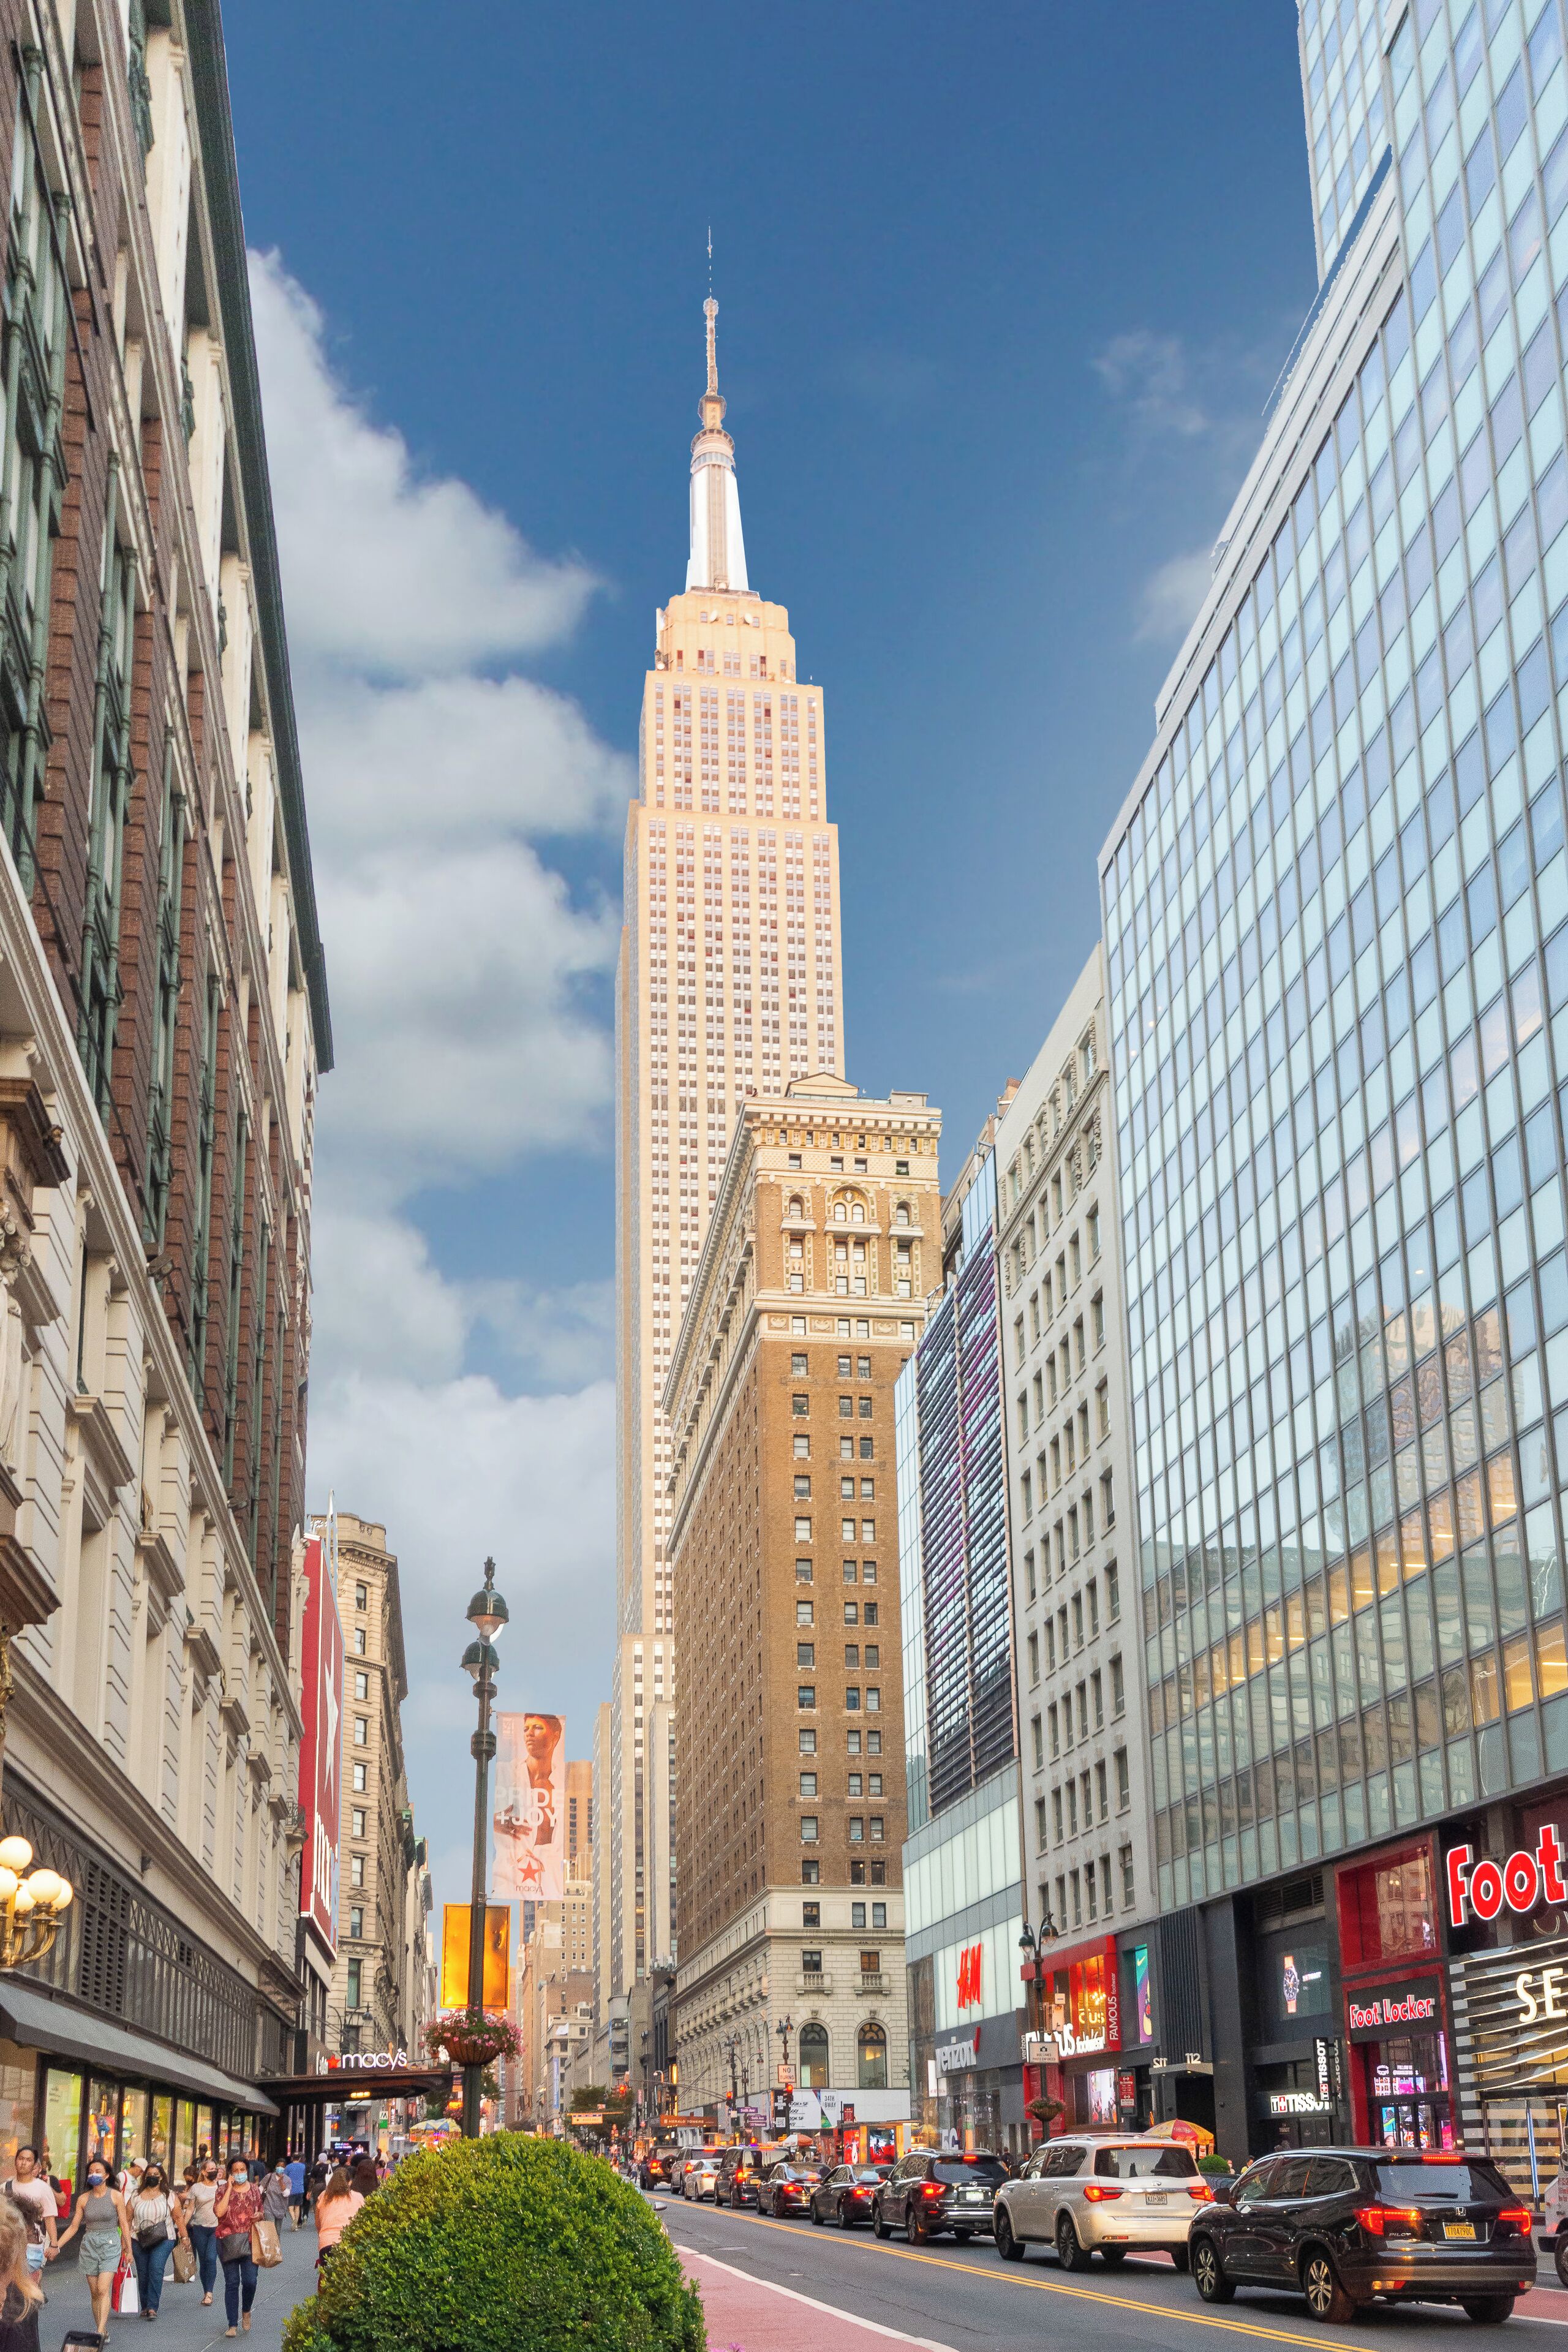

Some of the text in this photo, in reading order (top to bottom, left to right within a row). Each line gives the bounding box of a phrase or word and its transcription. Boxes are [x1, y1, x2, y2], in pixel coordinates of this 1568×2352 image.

[496, 1787, 565, 1807] PRIDE
[1447, 1823, 1568, 1927] Foot
[1107, 1996, 1119, 2040] FAMOUS
[1350, 1994, 1435, 2029] Foot Locker
[1185, 2053, 1201, 2064] 112
[1317, 2039, 1328, 2084] TISSOT
